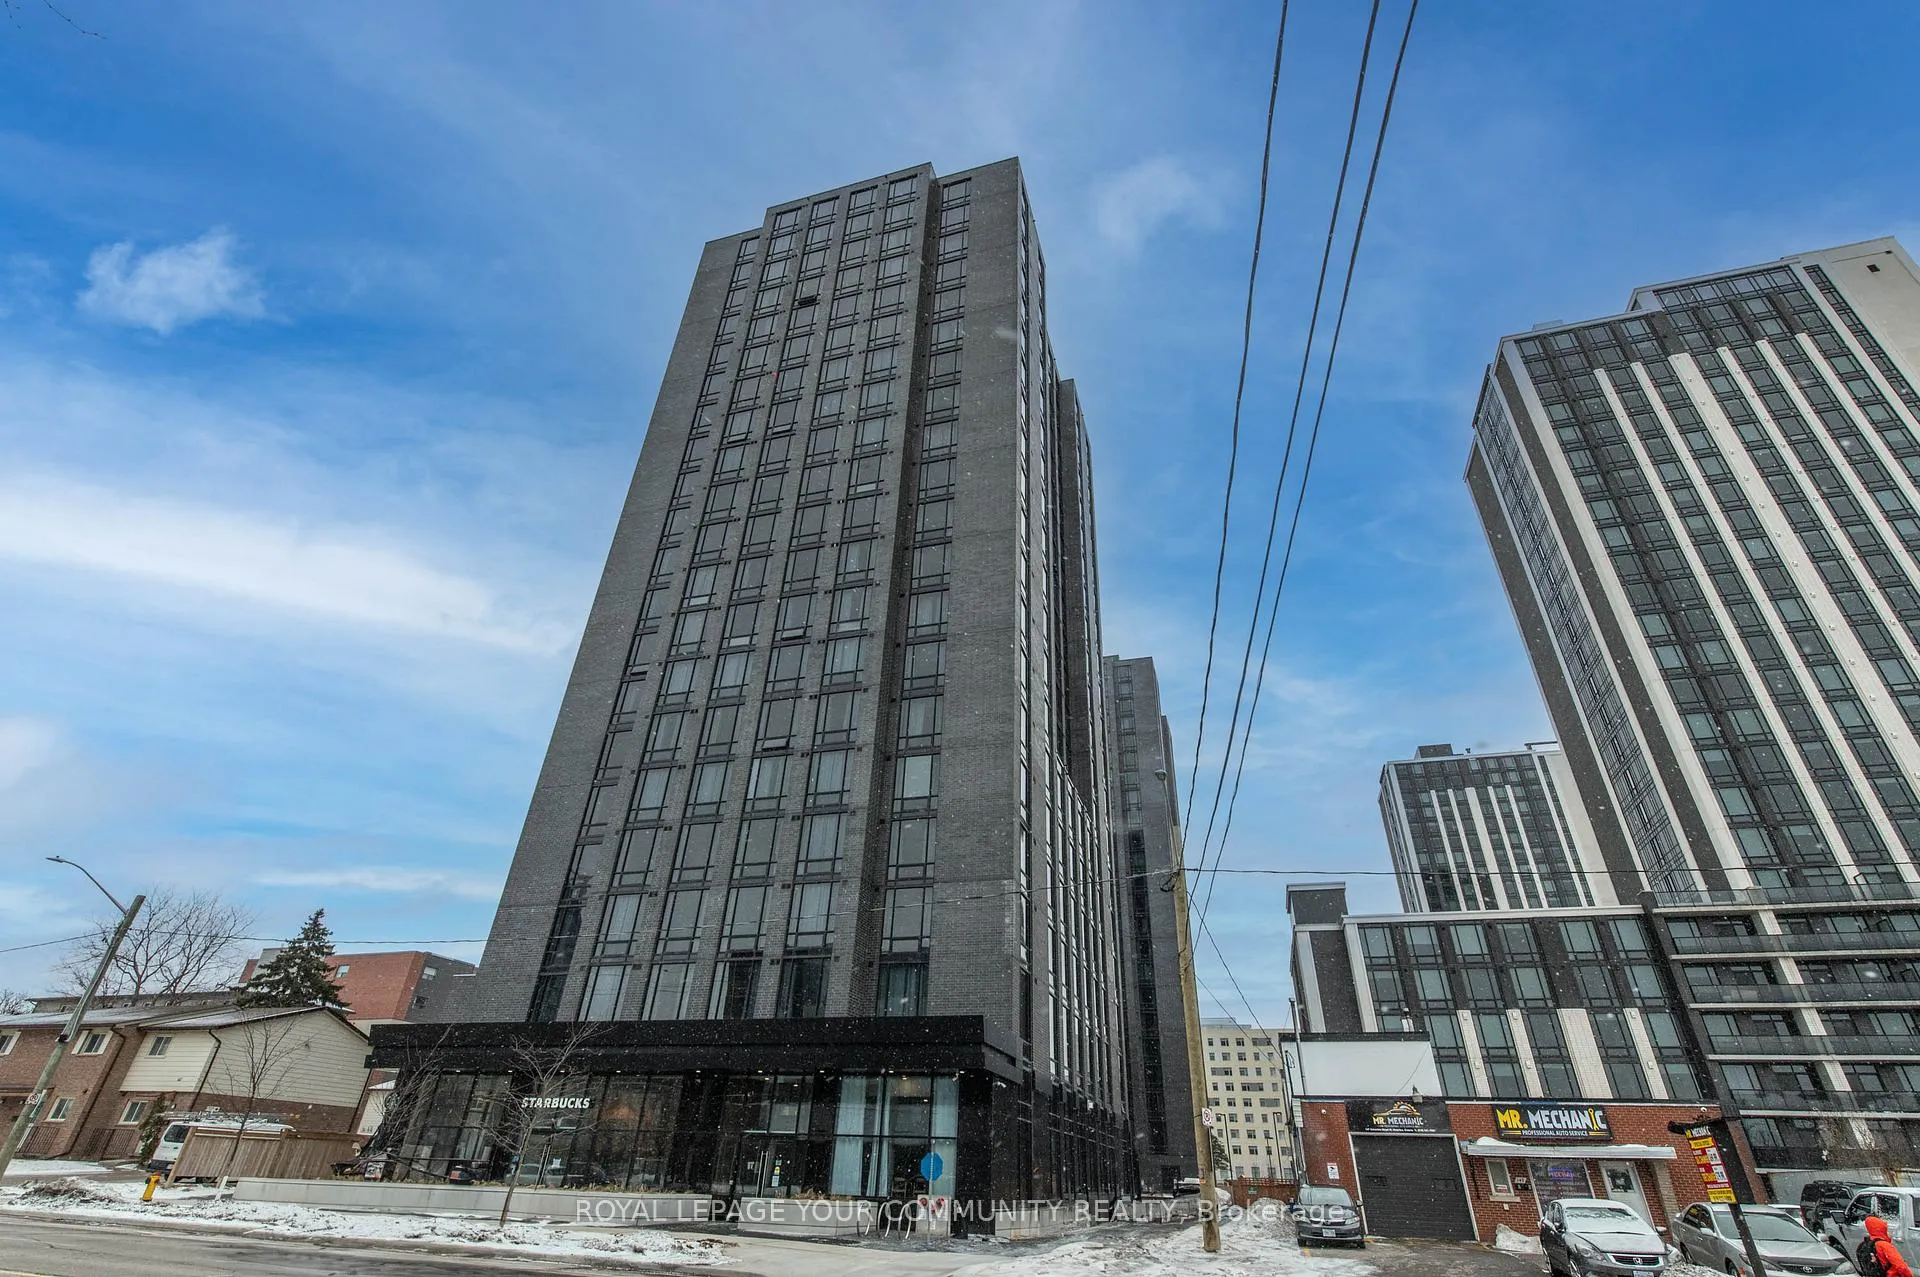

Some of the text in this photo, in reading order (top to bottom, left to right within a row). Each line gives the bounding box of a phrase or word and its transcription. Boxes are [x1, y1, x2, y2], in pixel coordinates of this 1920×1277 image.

[521, 1097, 591, 1109] STARBUCKS
[1387, 1117, 1424, 1126] MECHANIC
[1496, 1107, 1608, 1131] MR. MECHANIC
[1521, 1129, 1555, 1137] PROFESSIONAL
[1569, 1130, 1589, 1138] SERVICE
